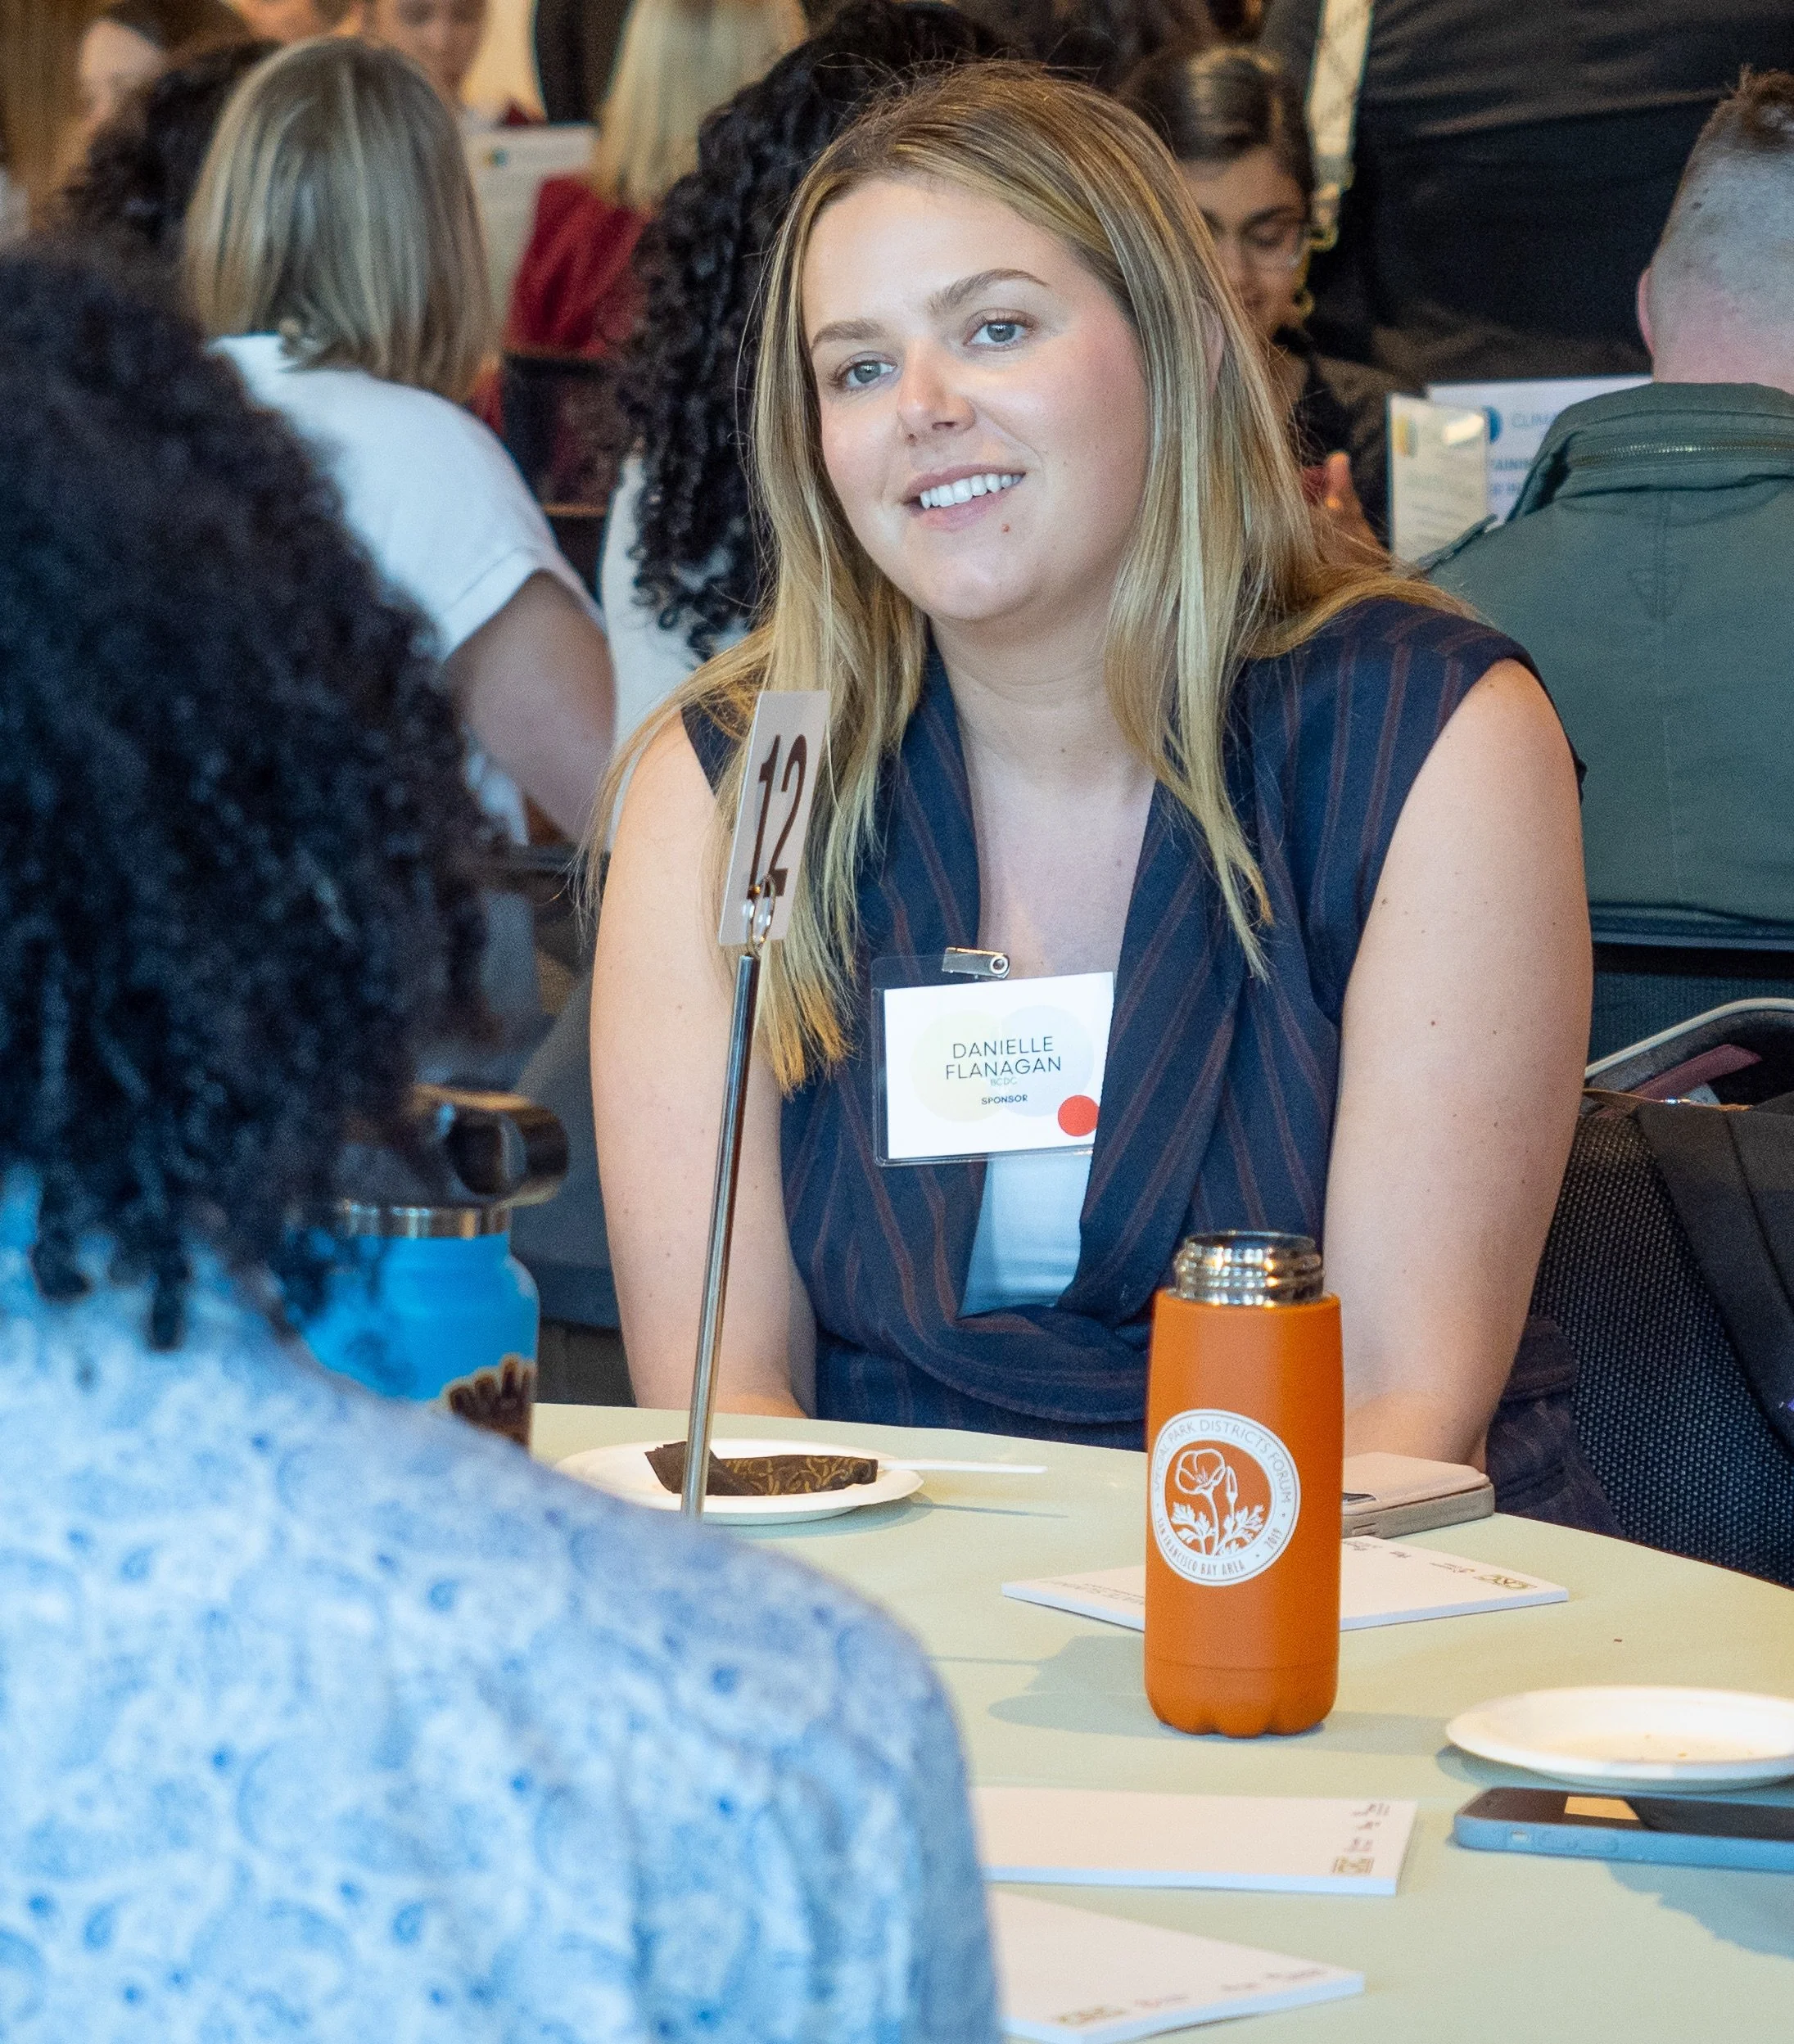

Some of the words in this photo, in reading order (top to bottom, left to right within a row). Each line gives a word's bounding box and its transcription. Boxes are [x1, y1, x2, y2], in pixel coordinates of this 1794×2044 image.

[746, 734, 807, 900] 12
[952, 1036, 1055, 1059] DANIELLE
[946, 1056, 1061, 1080] FLANAGAN
[991, 1076, 1018, 1086] BCDC
[981, 1094, 1028, 1105] SPONSOR
[1168, 1420, 1196, 1444] PARK
[1200, 1419, 1273, 1454] DISTRICTS
[1269, 1451, 1292, 1504] FORUM
[1163, 1535, 1199, 1572] FRANCISCO
[1200, 1563, 1218, 1576] BAY
[1222, 1559, 1246, 1576] AREA
